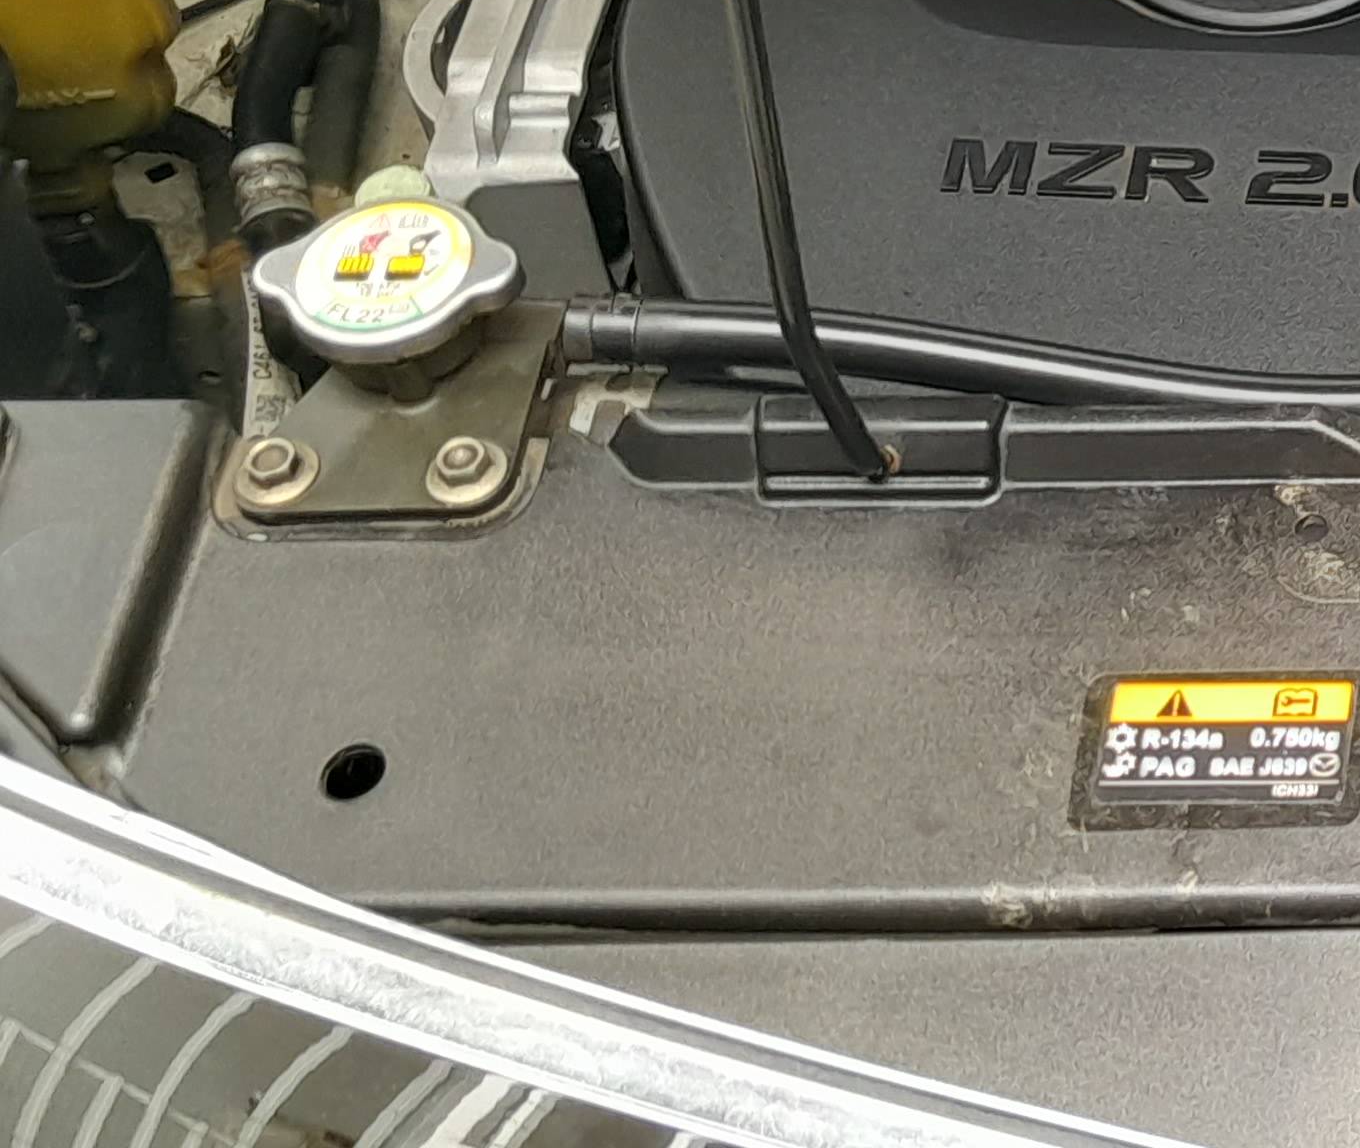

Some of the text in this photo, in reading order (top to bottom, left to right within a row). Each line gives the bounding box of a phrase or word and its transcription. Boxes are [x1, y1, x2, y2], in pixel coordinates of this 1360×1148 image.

[940, 137, 1217, 203] MZR
[327, 303, 385, 325] FL22
[1141, 727, 1341, 751] R-134a 0.750kg
[1139, 755, 1196, 778] PAG
[1209, 756, 1255, 777] SAE
